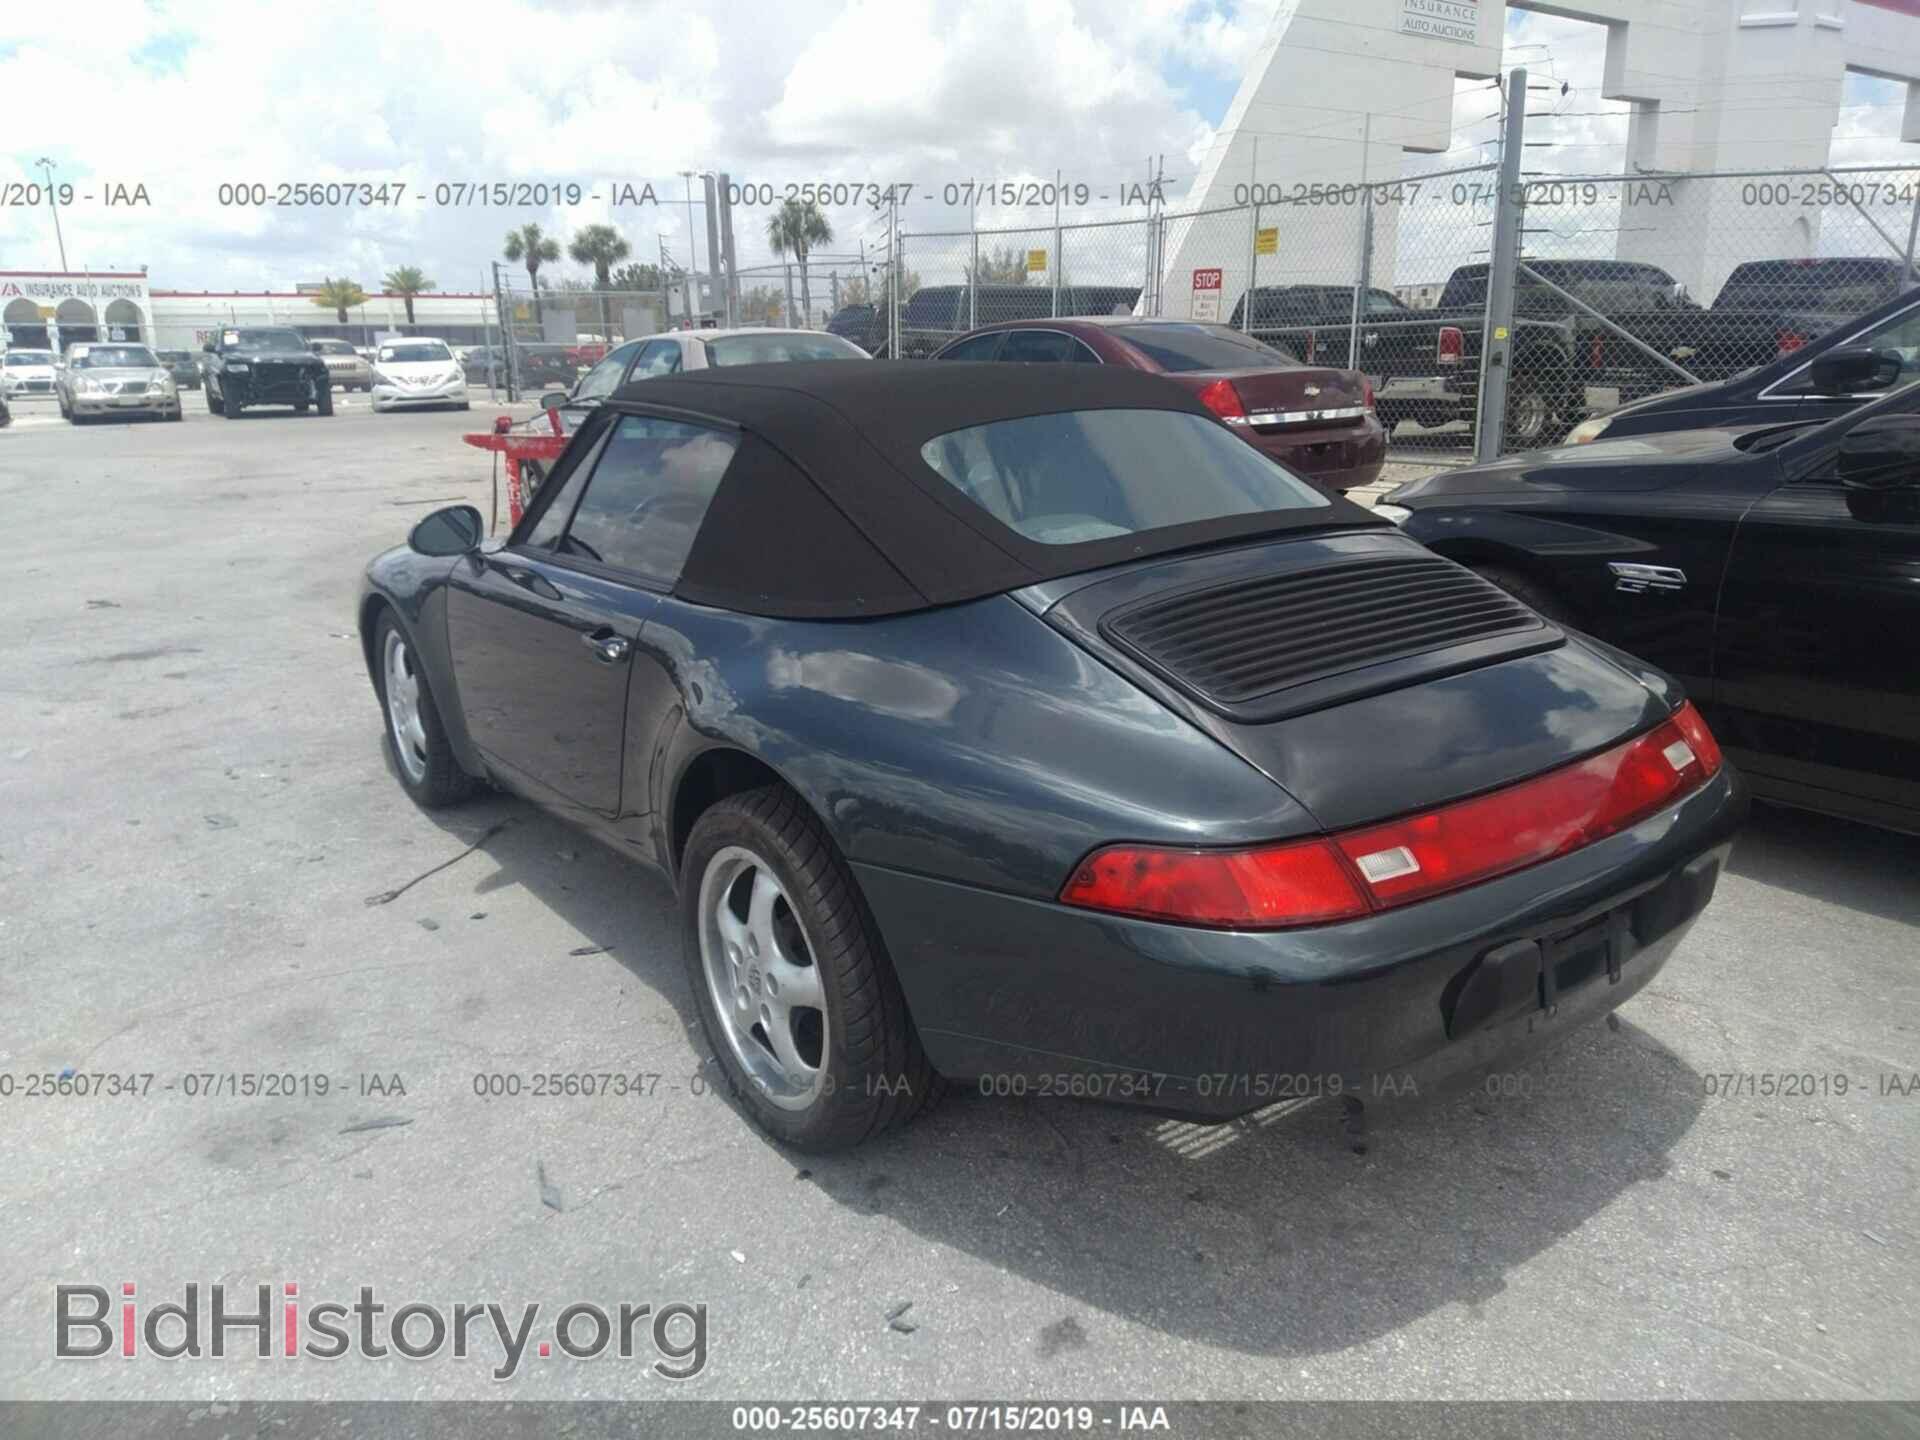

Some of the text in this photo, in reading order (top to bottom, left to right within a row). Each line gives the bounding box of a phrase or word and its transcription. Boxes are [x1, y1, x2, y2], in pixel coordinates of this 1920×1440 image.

[1403, 0, 1476, 20] INSURANCE
[1402, 18, 1476, 40] AUTO AUCTIONS
[1195, 272, 1220, 288] STOP
[25, 283, 73, 297] INSURANCE
[76, 284, 98, 297] AUTO
[101, 285, 142, 298] AUCTIONS
